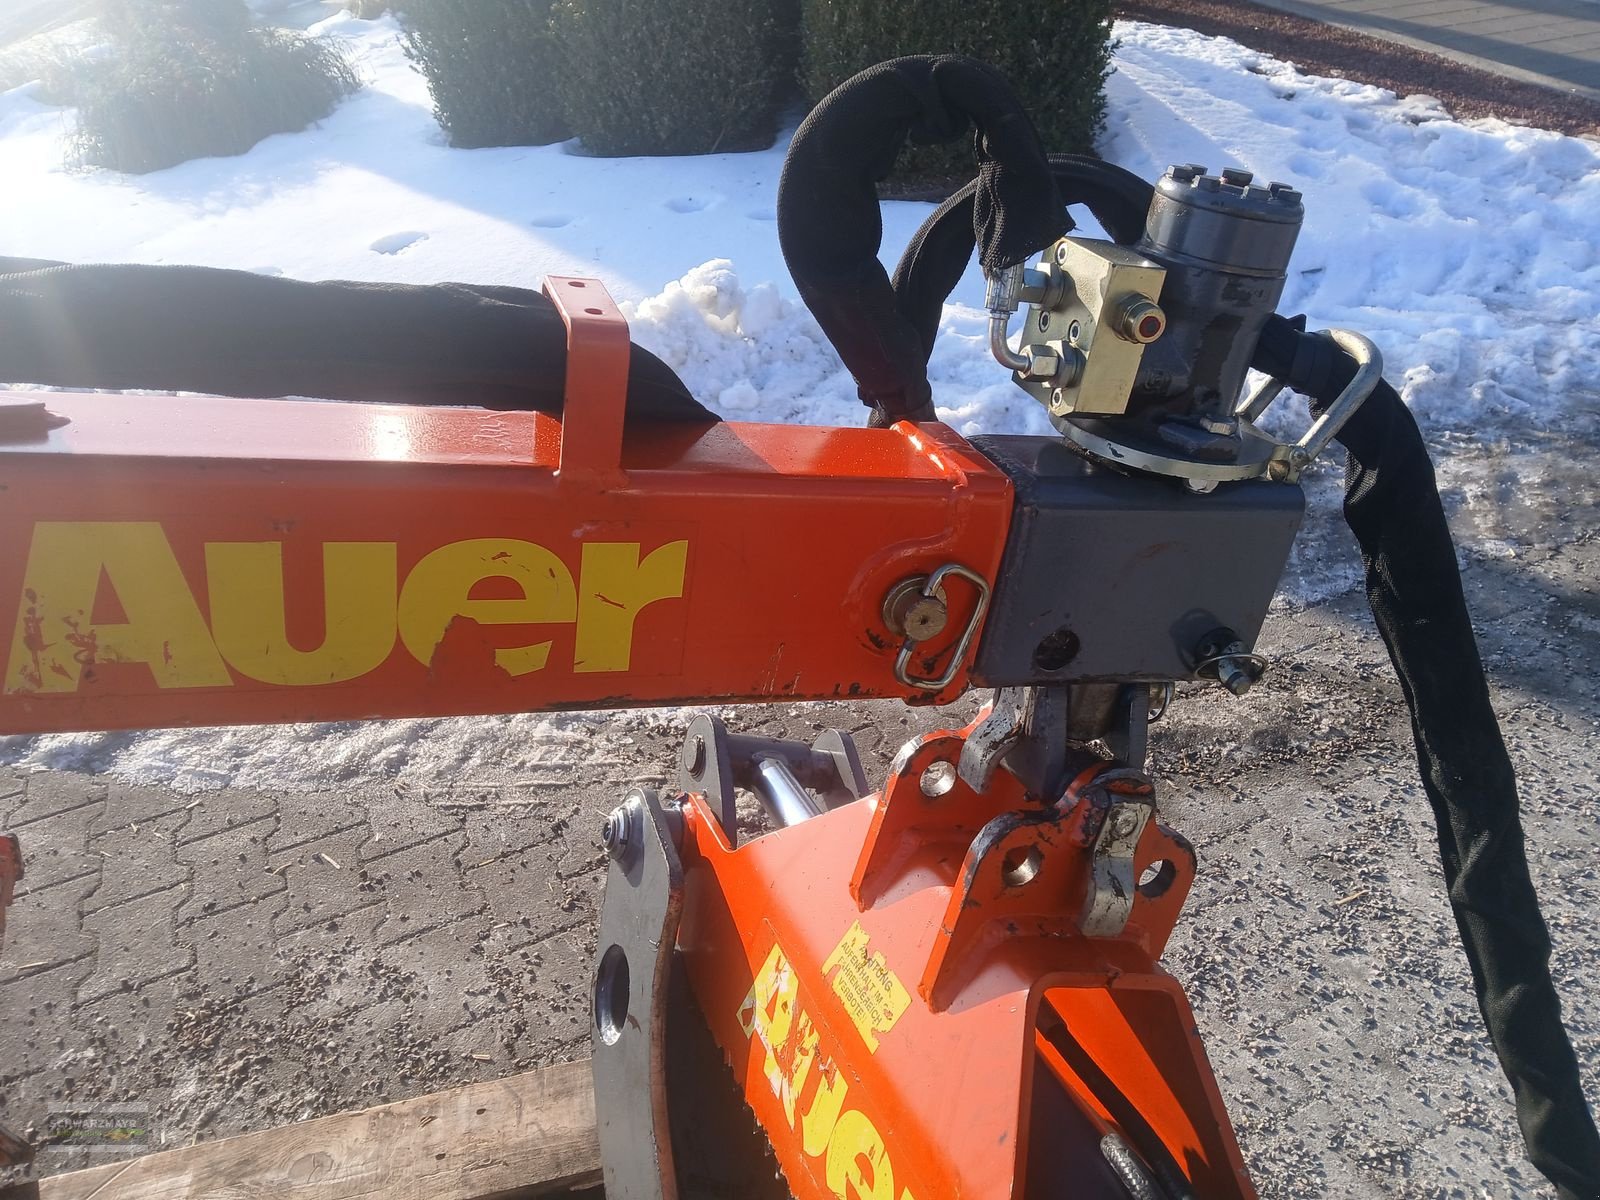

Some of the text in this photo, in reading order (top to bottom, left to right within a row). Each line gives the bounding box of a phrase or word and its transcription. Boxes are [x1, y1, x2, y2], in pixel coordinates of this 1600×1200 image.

[3, 520, 688, 694] Auer
[841, 942, 884, 1006] AUFENTHALT IM
[859, 944, 893, 992] AHTUNG
[736, 942, 917, 1200] Aue
